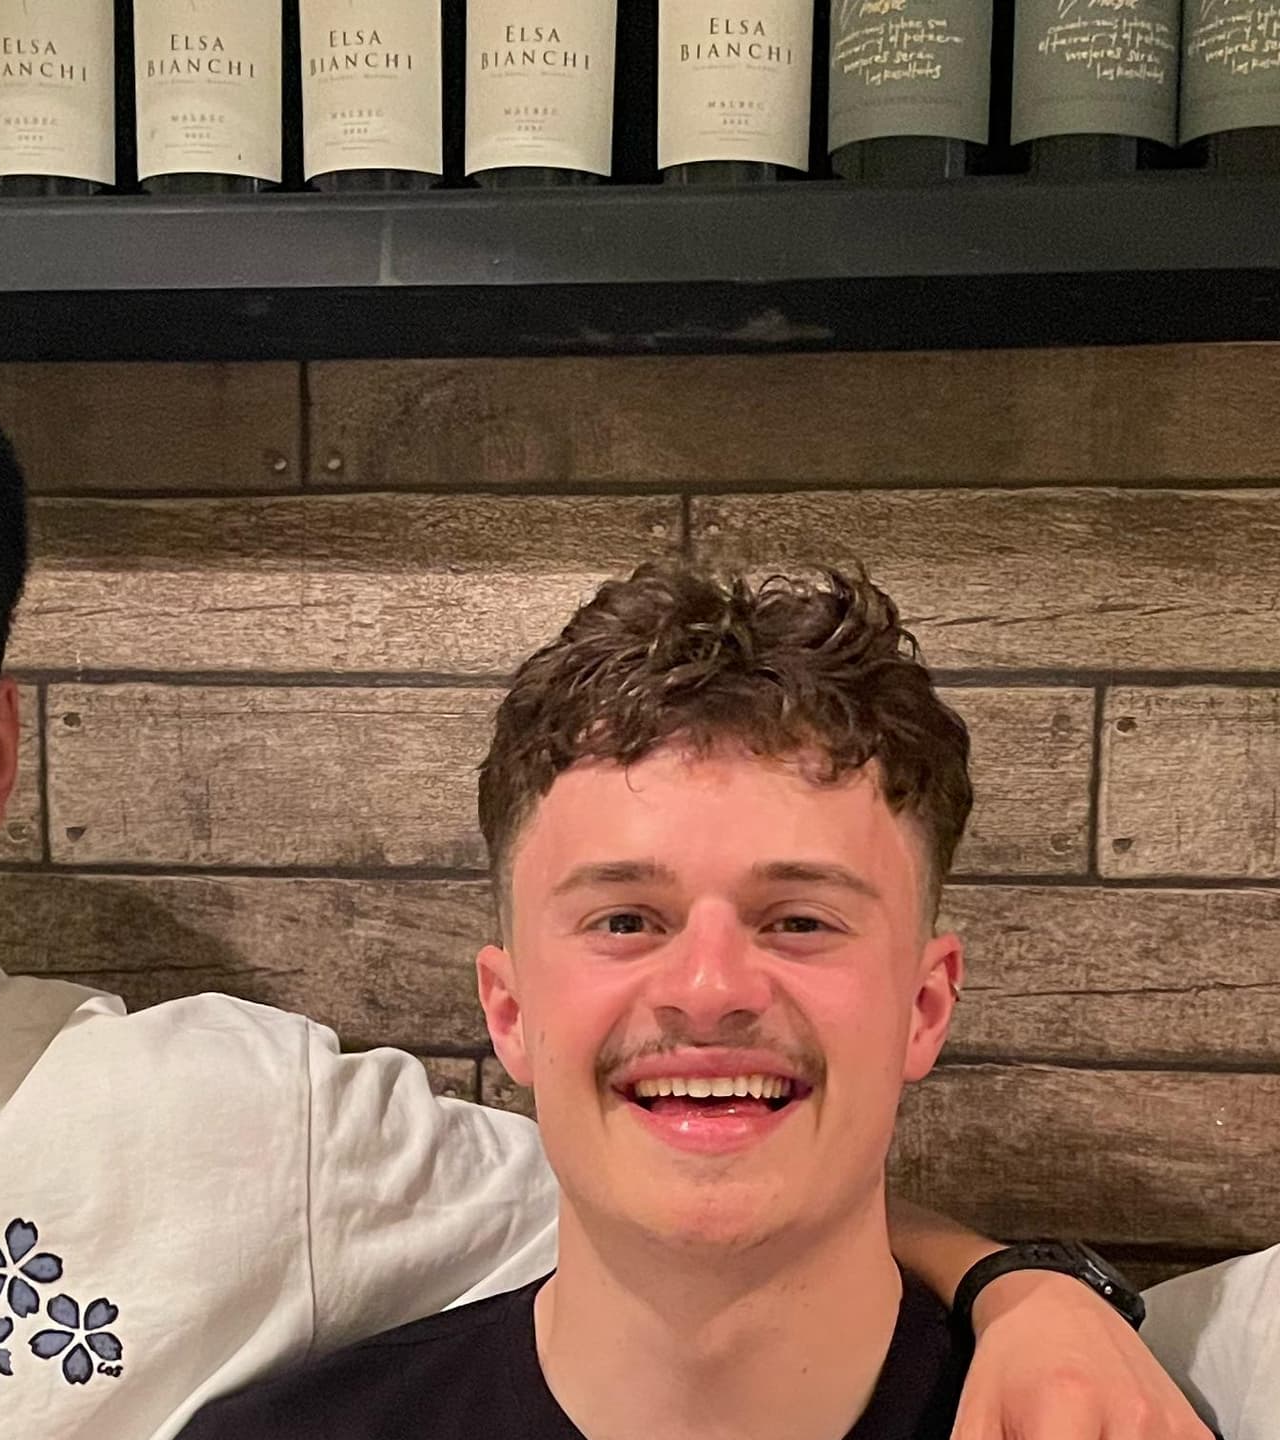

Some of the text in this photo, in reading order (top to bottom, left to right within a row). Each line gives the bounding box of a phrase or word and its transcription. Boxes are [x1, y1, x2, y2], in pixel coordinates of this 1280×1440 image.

[505, 24, 562, 44] ELSA
[709, 17, 766, 37] ELSA
[1, 36, 58, 56] ELSA
[170, 33, 225, 52] ELSA
[329, 29, 383, 48] ELSA
[480, 49, 590, 71] BIANCHI
[679, 42, 793, 65] BIANCHI
[146, 57, 256, 79] BIANCHI
[309, 52, 413, 77] BIANCHI
